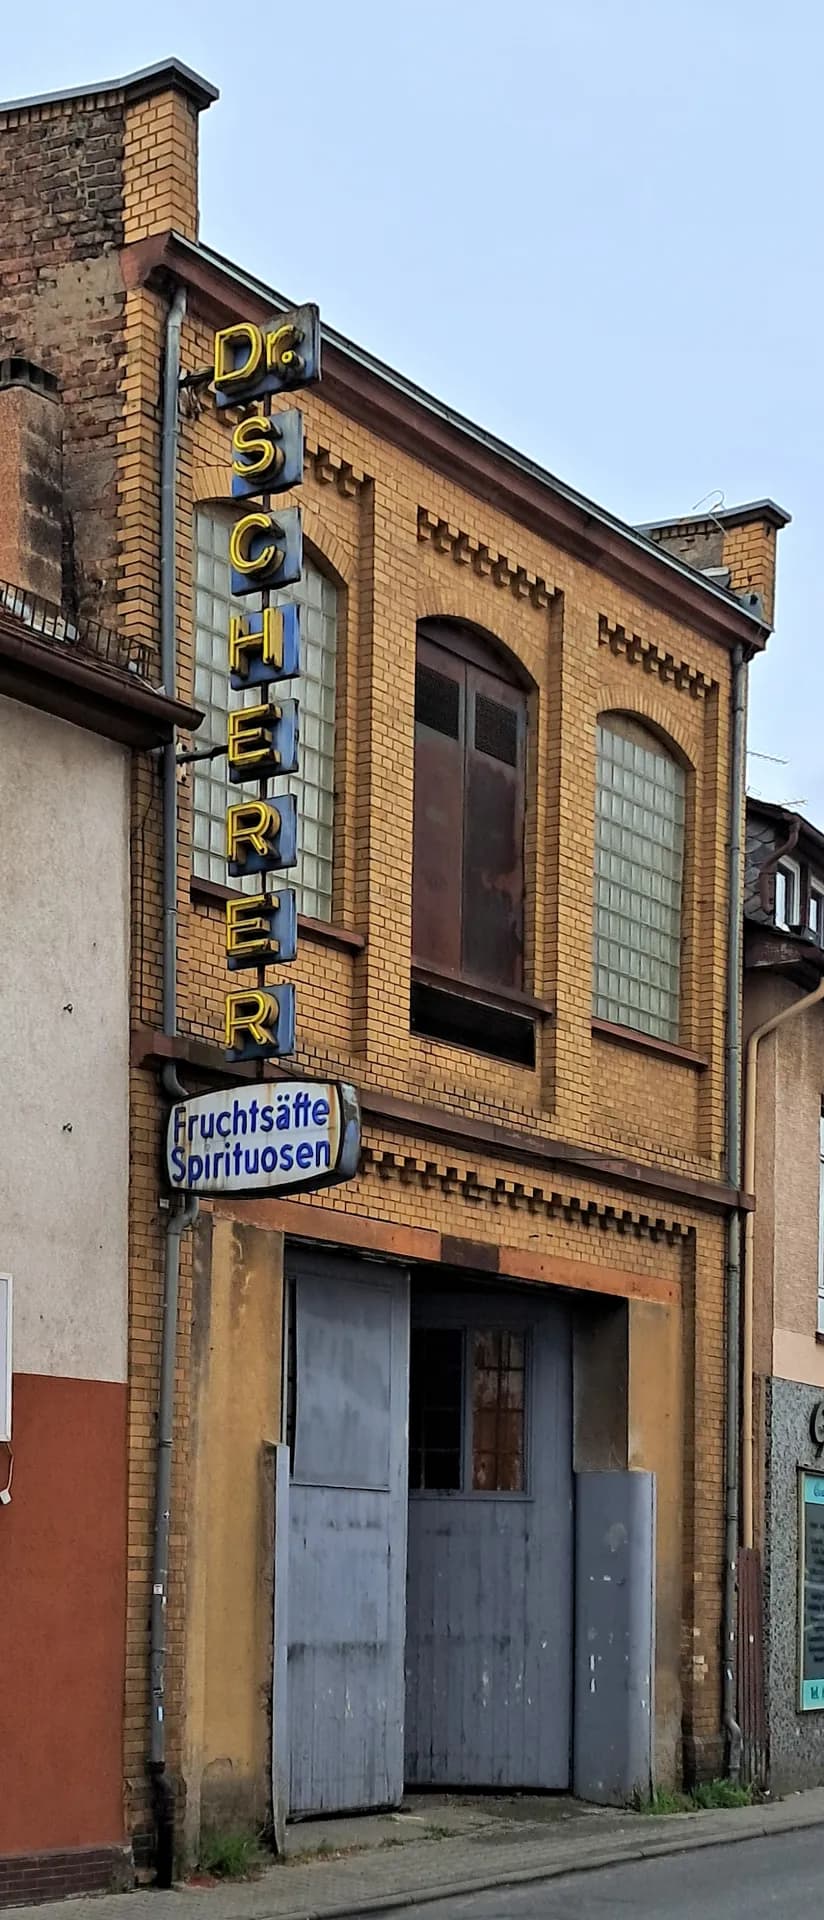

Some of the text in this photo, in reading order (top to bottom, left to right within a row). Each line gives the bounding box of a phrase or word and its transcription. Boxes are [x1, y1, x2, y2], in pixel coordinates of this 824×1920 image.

[214, 322, 303, 1048] Dr. SCHERER
[173, 1091, 330, 1143] Fruchtsäfte
[171, 1140, 331, 1187] Spirituosen
